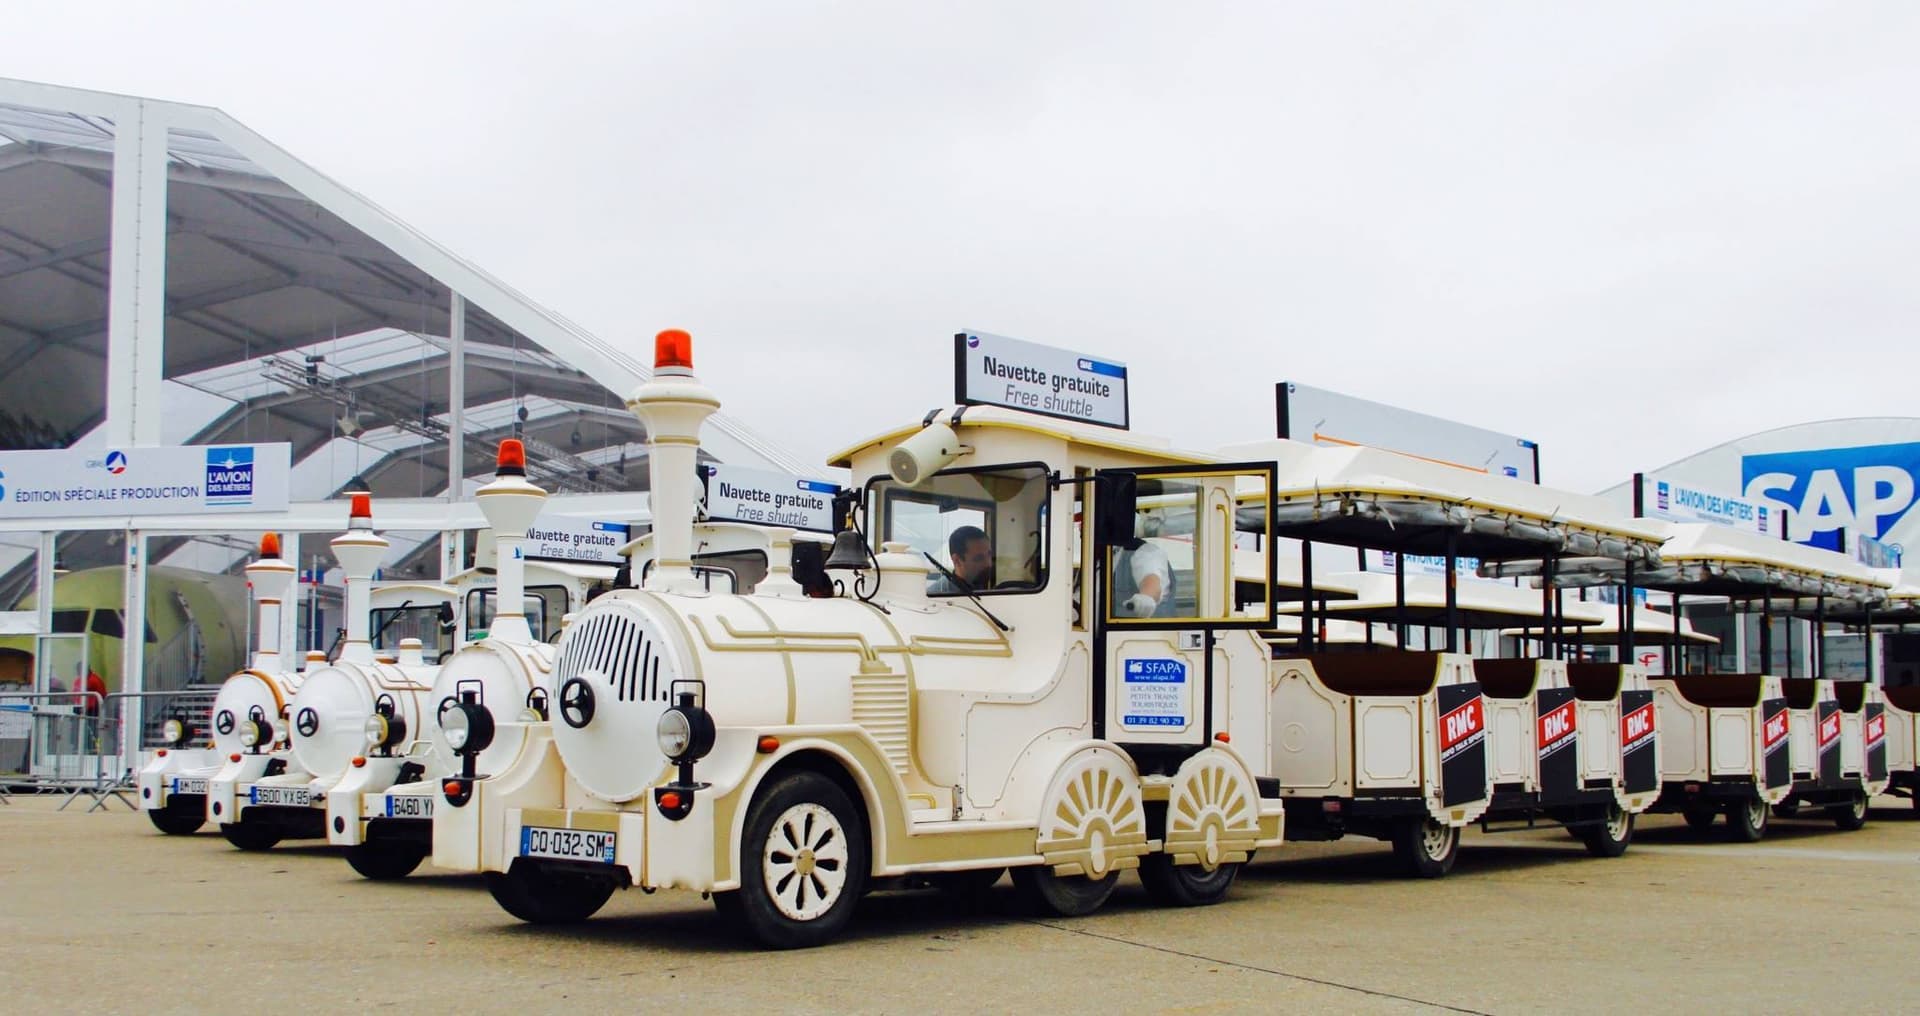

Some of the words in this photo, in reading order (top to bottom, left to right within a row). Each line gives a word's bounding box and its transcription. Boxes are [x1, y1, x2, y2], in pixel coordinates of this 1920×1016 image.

[983, 355, 1047, 386] Navette
[1051, 373, 1110, 398] gratuite
[1004, 384, 1039, 407] Free
[1043, 393, 1093, 418] shuttle
[208, 471, 251, 484] L'AVION
[15, 488, 62, 502] ÉDITION
[64, 486, 118, 501] SPÉCIALE
[121, 486, 199, 499] PRODUCTION
[719, 481, 772, 503] Navette
[774, 493, 824, 510] gratuite
[1675, 487, 1705, 509] L'AVION
[1706, 495, 1721, 514] DES
[1744, 465, 1915, 542] SAP
[735, 503, 764, 521] Free
[767, 508, 809, 527] shuttle
[526, 527, 570, 542] Navette
[573, 533, 616, 547] gratuite
[539, 543, 565, 557] Free
[567, 547, 603, 560] shuttle
[1145, 662, 1182, 674] SFAPA
[1127, 716, 1136, 724] 01
[1446, 704, 1476, 743] RMC
[1543, 707, 1570, 742] RMC
[1627, 709, 1649, 740] RMC
[1766, 713, 1785, 742] RMC
[256, 788, 281, 804] 3600
[394, 797, 419, 816] 6460
